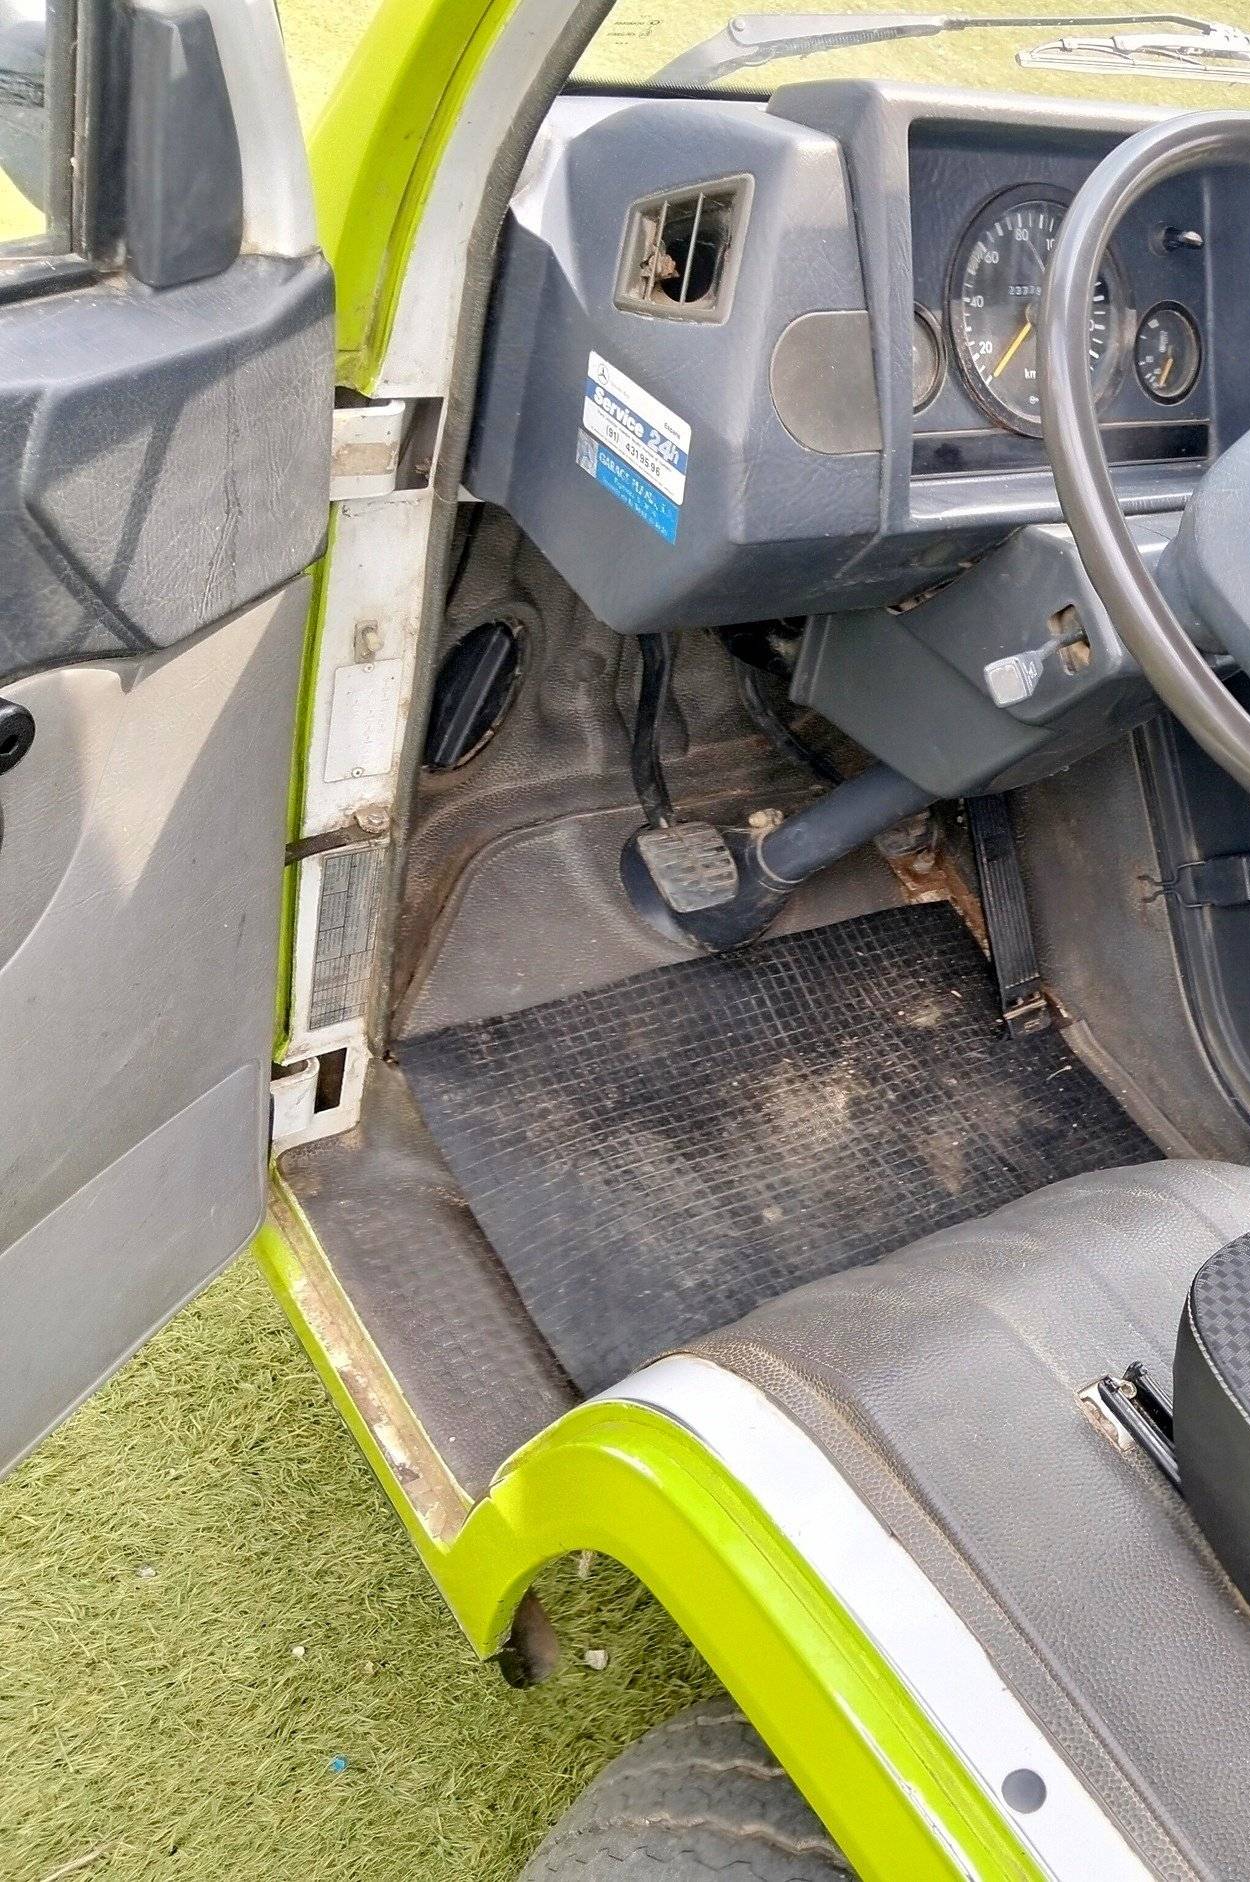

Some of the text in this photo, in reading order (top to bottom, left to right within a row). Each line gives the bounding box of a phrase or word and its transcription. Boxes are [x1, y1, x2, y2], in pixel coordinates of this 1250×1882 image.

[1014, 228, 1029, 242] 80
[984, 251, 999, 264] 60
[970, 295, 984, 308] 40
[978, 341, 993, 354] 20
[593, 386, 645, 440] Service
[647, 428, 680, 465] 24h
